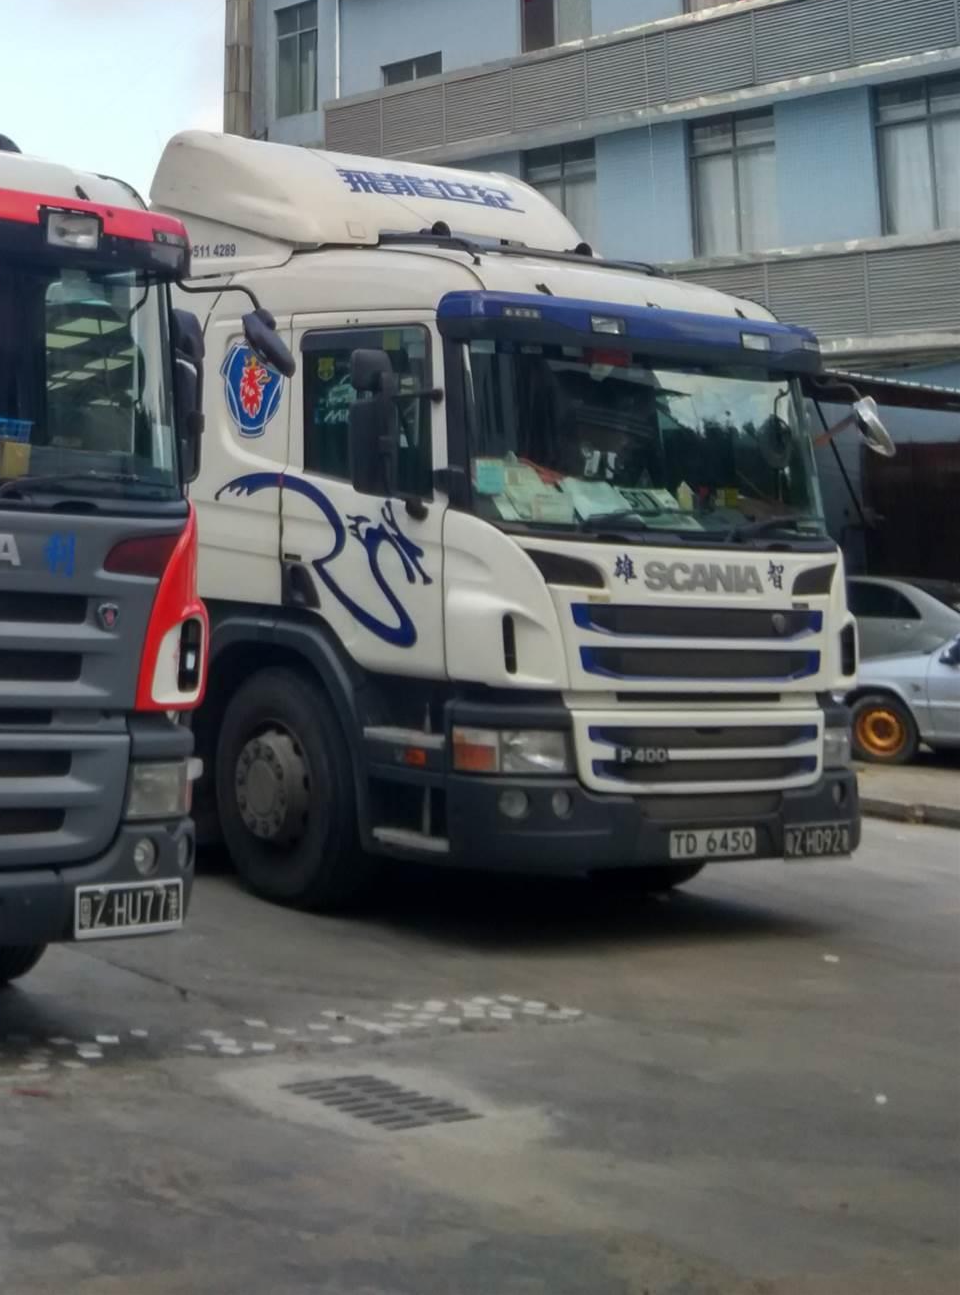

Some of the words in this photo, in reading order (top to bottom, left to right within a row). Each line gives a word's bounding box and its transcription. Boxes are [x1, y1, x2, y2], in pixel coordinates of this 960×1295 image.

[336, 168, 526, 214] 飛龍世紀
[190, 244, 210, 259] 511
[213, 242, 237, 258] 4289
[643, 560, 764, 594] SCANIA
[767, 559, 785, 591] 智
[621, 748, 633, 763] P
[634, 747, 667, 763] 400
[673, 833, 698, 855] TD
[705, 830, 754, 853] 6450
